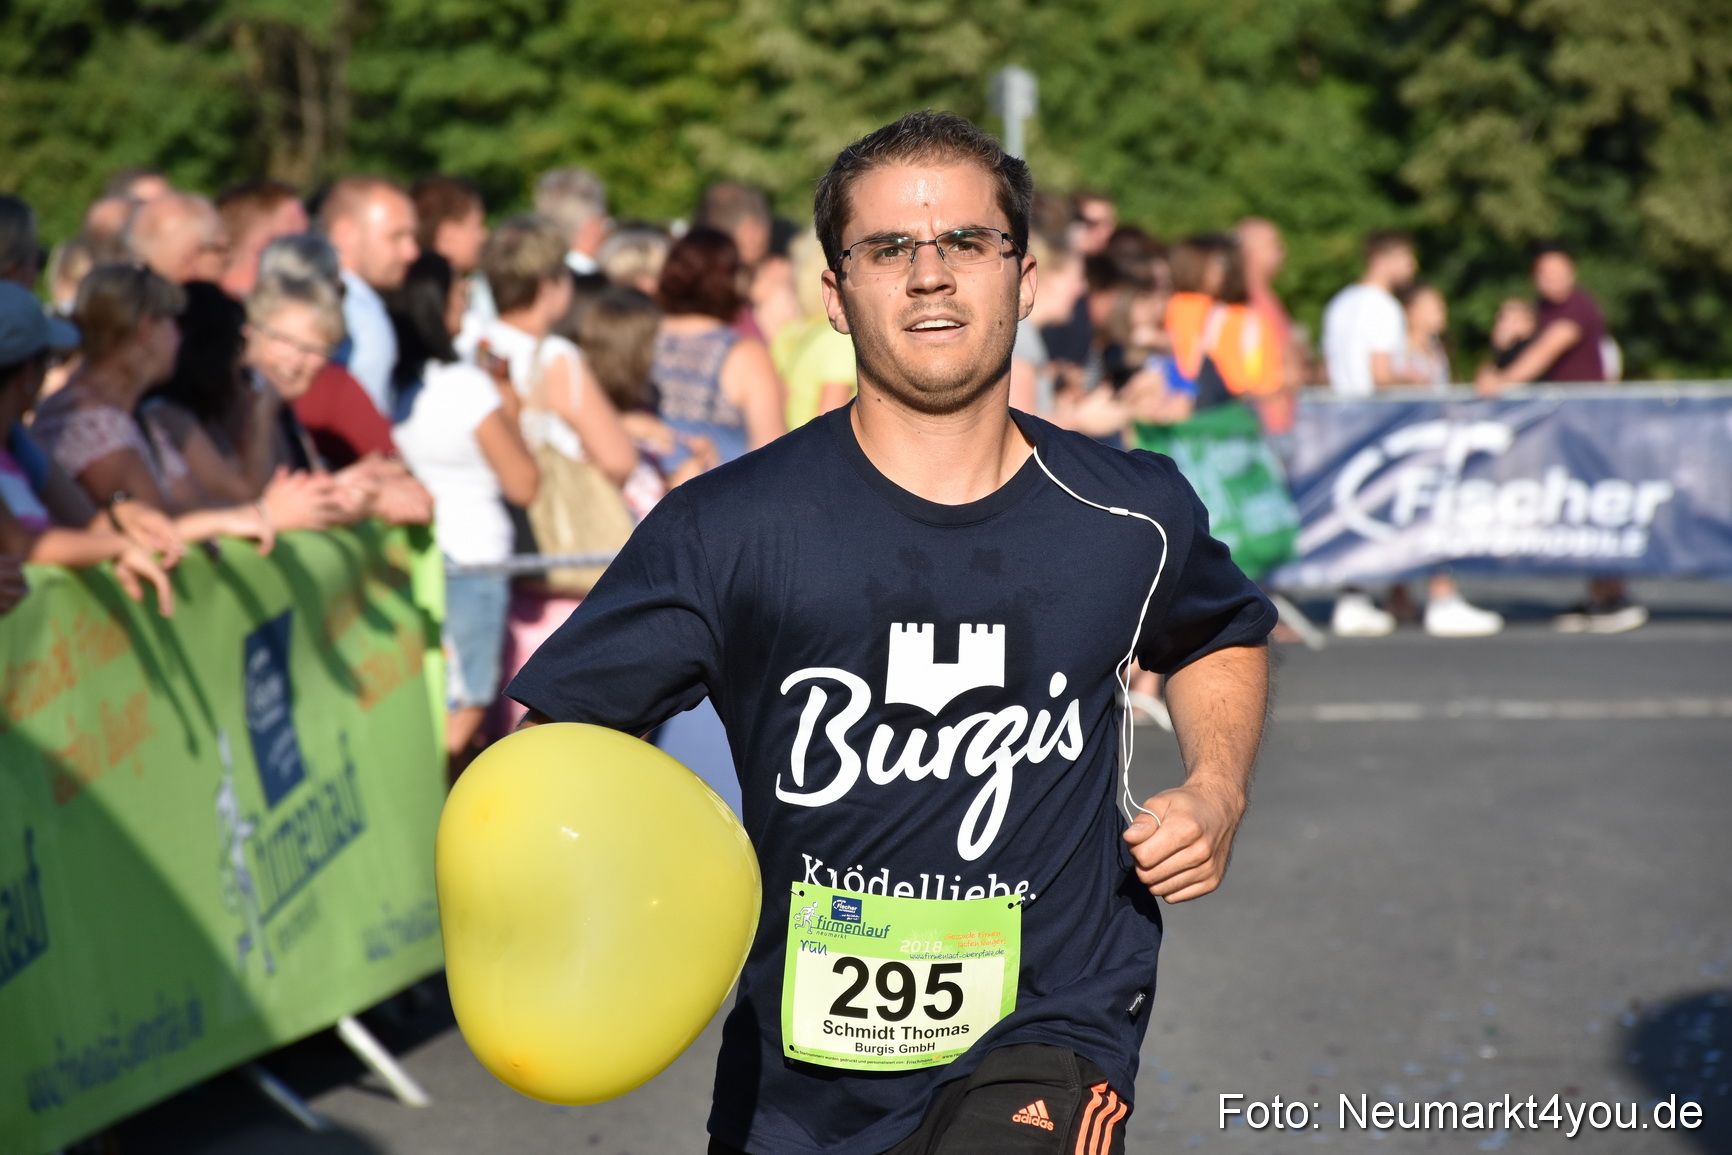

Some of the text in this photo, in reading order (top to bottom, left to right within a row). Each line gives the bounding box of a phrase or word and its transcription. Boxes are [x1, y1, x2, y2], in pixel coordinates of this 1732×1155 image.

[1389, 462, 1675, 529] Fischer
[775, 667, 1084, 861] Burgis
[816, 931, 847, 939] neumarkt
[817, 915, 891, 939] firmenlauf
[900, 940, 943, 953] 2018
[829, 956, 964, 1022] 295
[822, 1020, 970, 1040] Schmidt Thomas
[855, 1042, 936, 1056] Burgis GmbH
[1012, 1113, 1054, 1132] adidas
